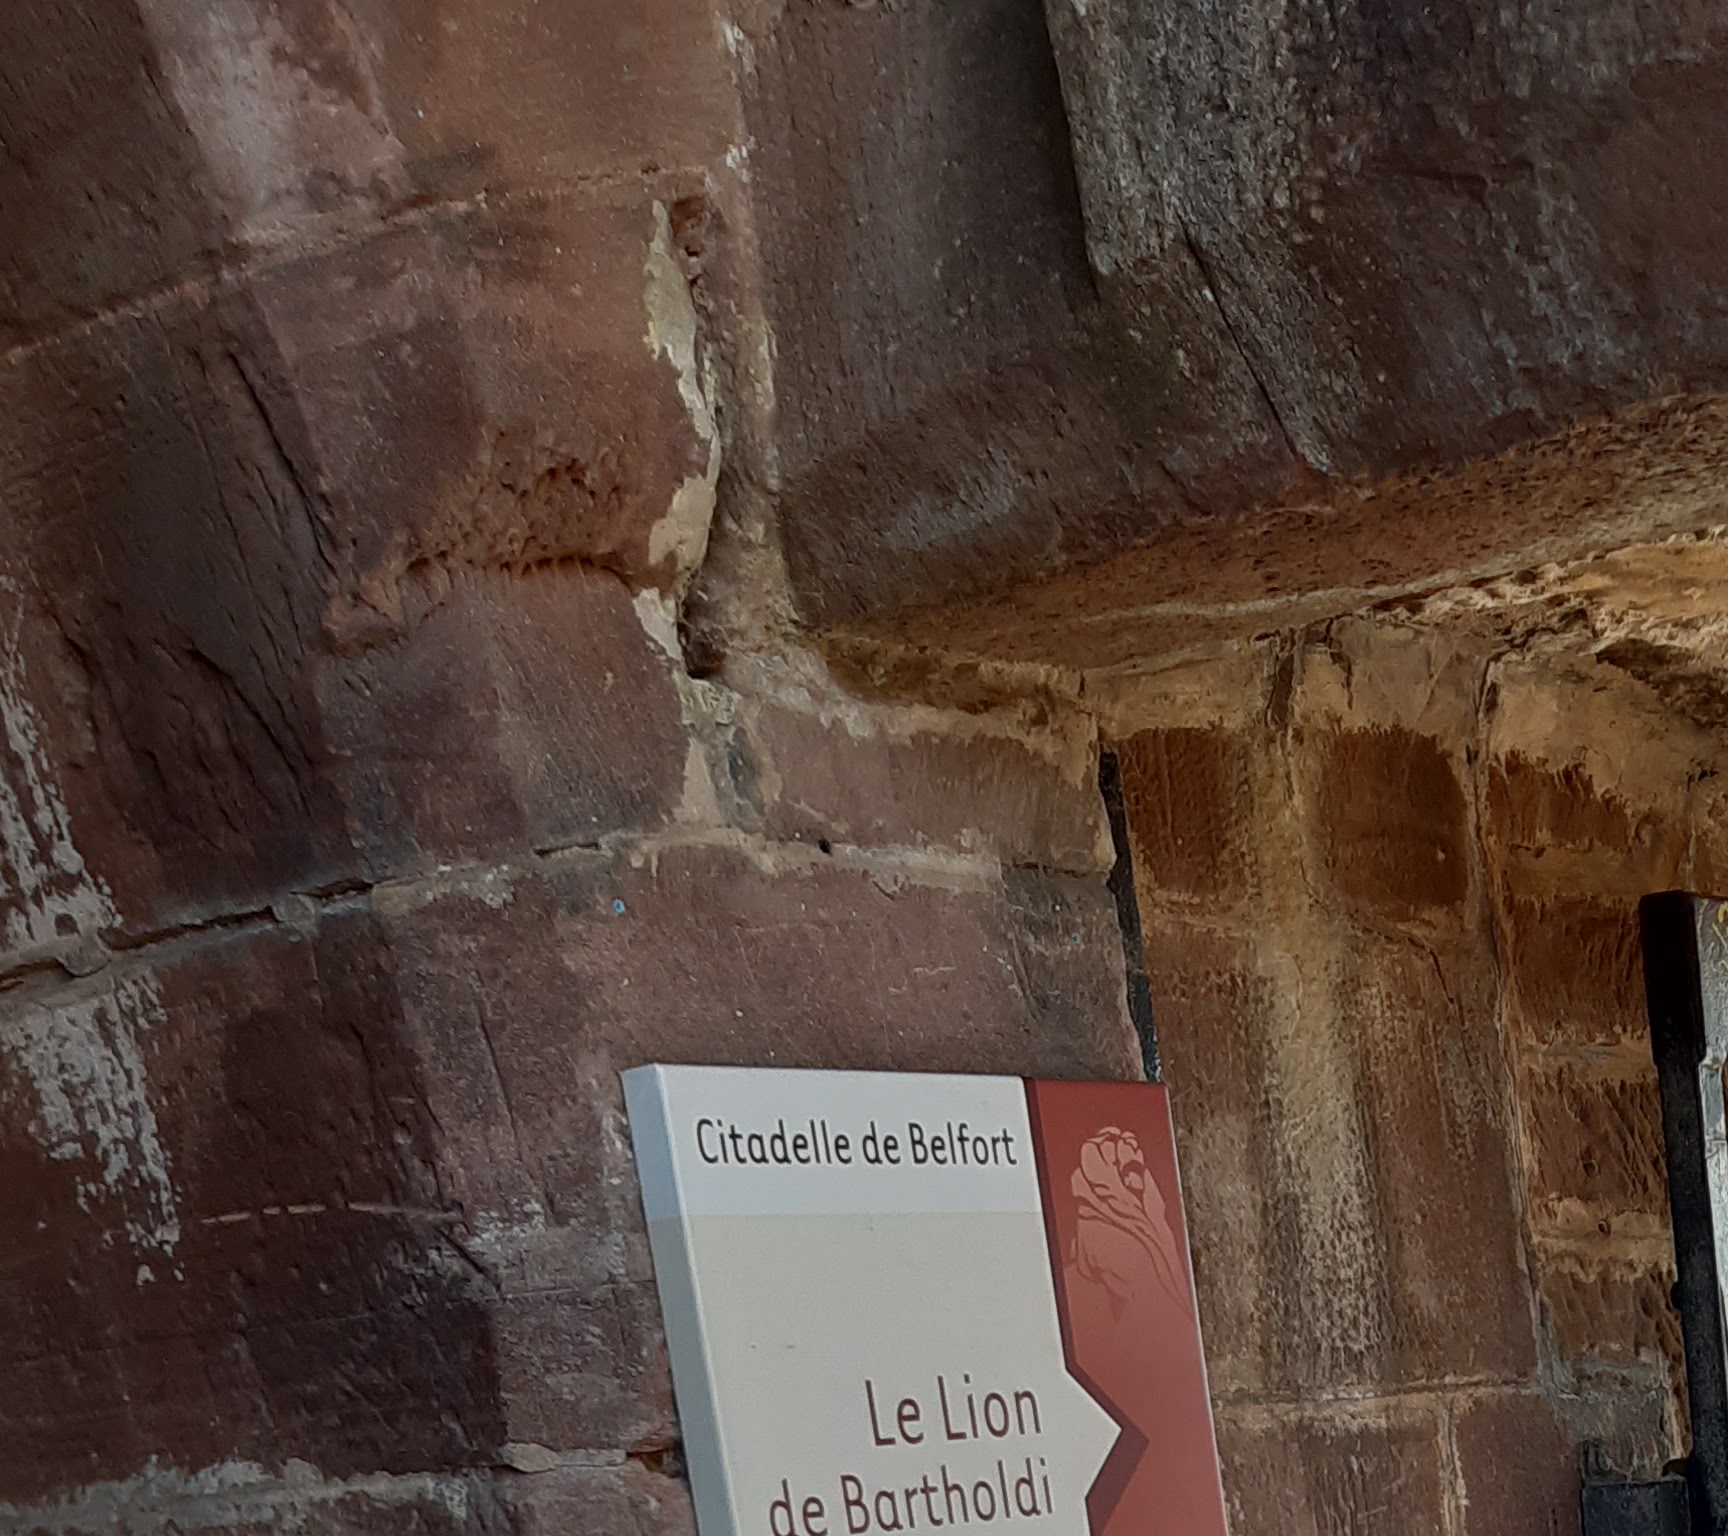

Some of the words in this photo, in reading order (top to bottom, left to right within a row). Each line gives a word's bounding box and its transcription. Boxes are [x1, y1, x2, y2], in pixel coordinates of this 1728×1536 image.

[696, 1118, 852, 1165] Citadelle
[862, 1120, 900, 1165] de
[908, 1121, 1017, 1165] Belfort
[865, 1379, 924, 1446] Le
[937, 1373, 1041, 1440] Lion
[840, 1457, 1053, 1535] Bartholdi
